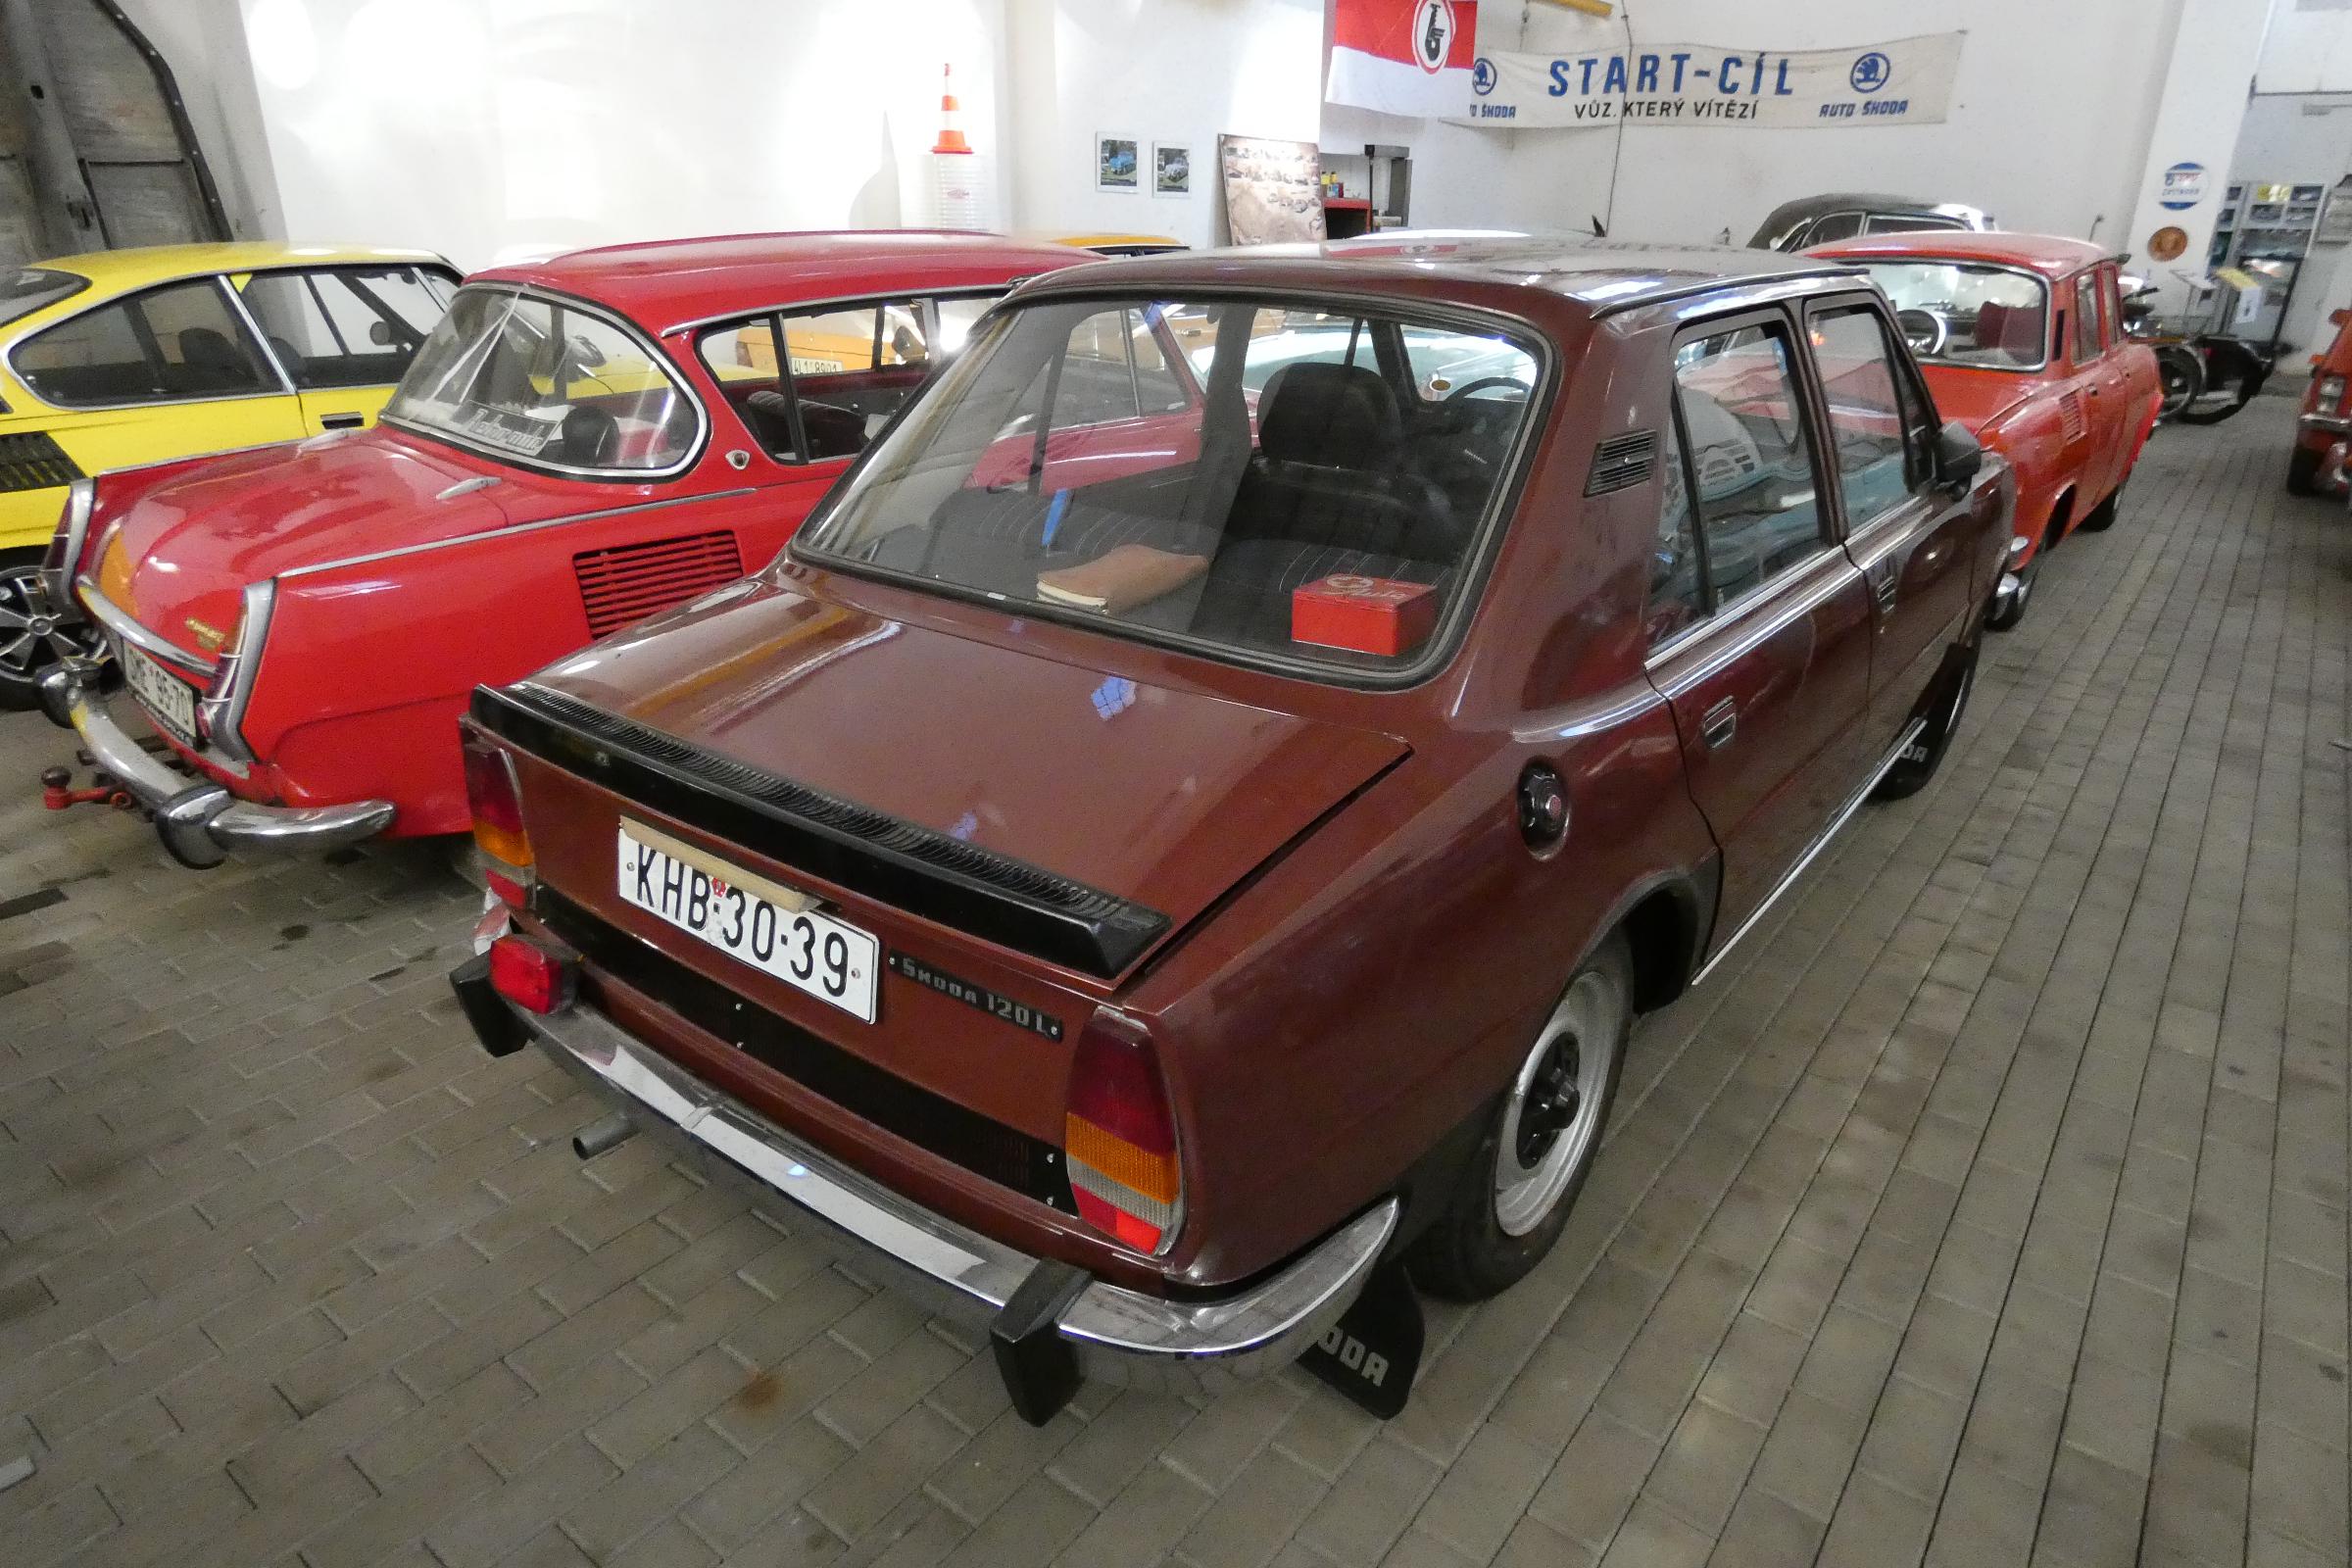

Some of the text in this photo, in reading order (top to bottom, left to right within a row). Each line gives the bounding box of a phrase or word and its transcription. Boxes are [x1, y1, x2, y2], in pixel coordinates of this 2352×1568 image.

[1548, 51, 1794, 97] START-CÍL
[1623, 98, 1685, 118] KTERÝ
[1693, 99, 1759, 119] VÍTĚZÍ
[1819, 103, 1857, 118] AUTO
[1318, 1326, 1390, 1388] ODA
